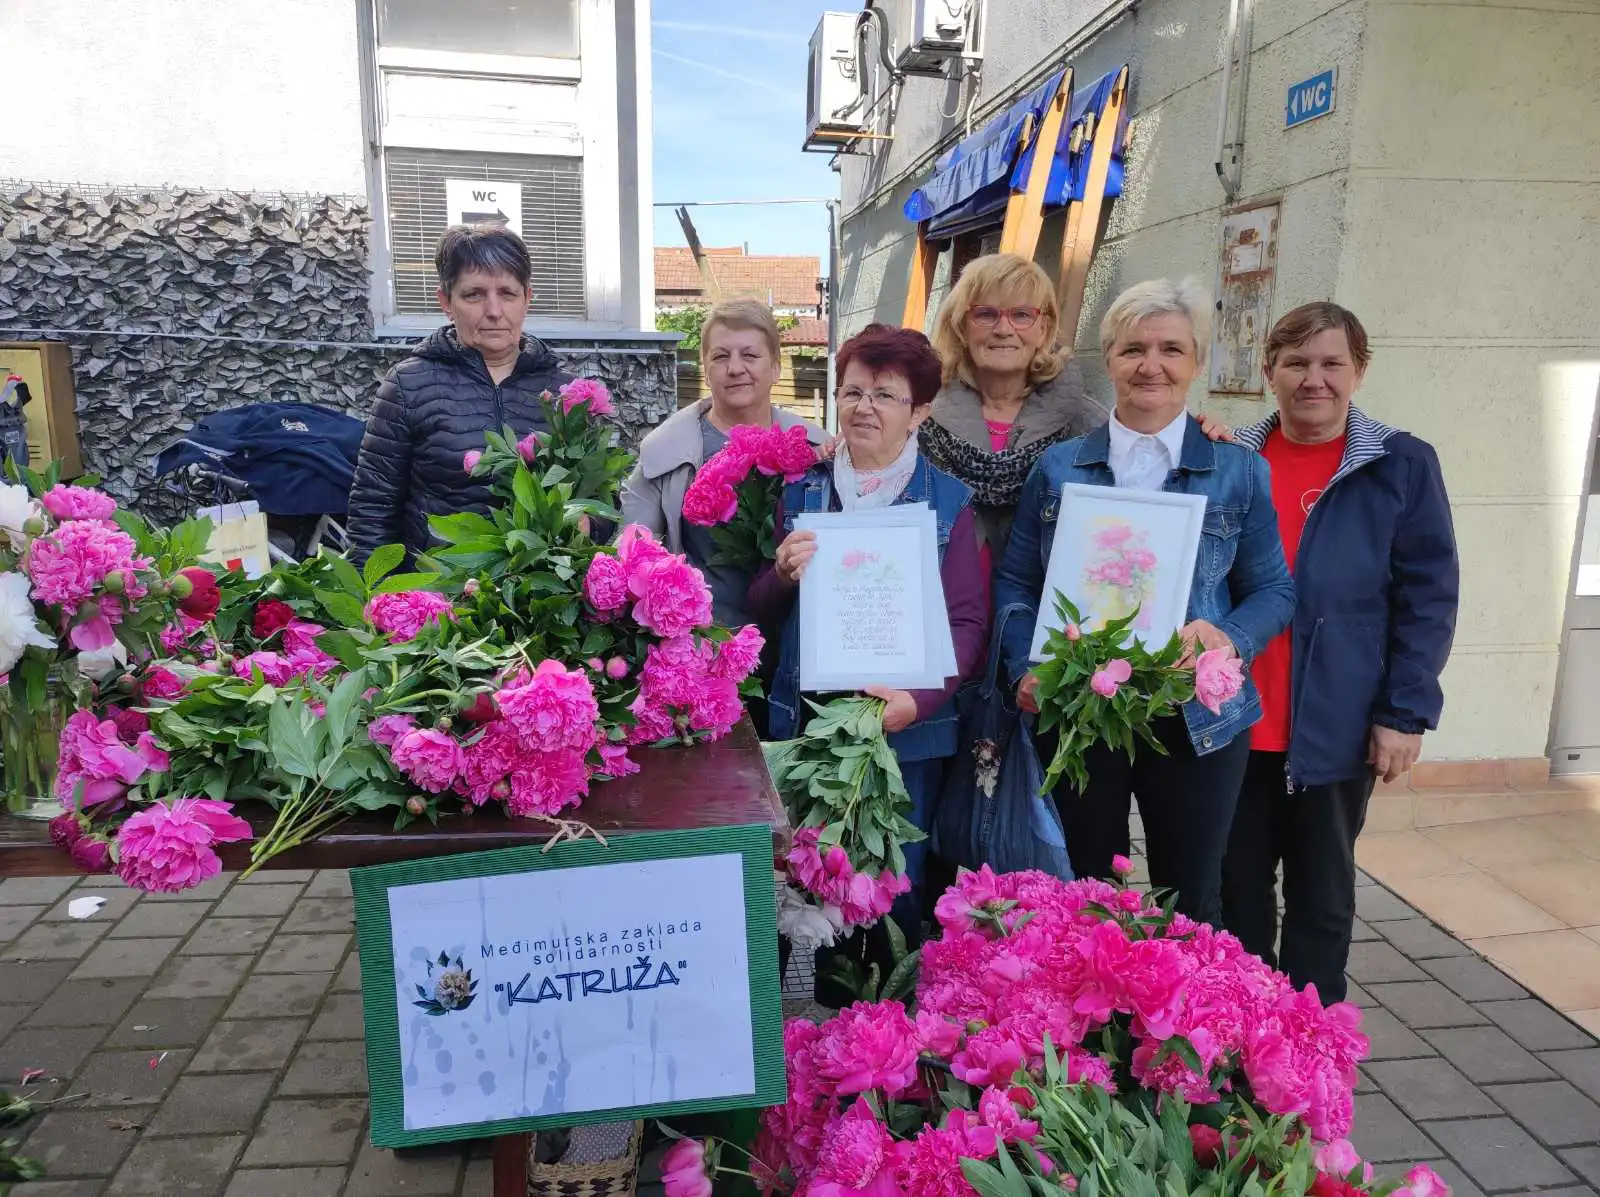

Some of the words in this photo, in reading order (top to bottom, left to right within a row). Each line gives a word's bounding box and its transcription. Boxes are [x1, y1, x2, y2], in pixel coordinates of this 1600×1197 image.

[1301, 81, 1326, 113] WC
[472, 190, 497, 202] WC
[480, 932, 608, 959] Međimurska
[621, 920, 702, 940] zaklada
[533, 939, 662, 965] solidarnosti
